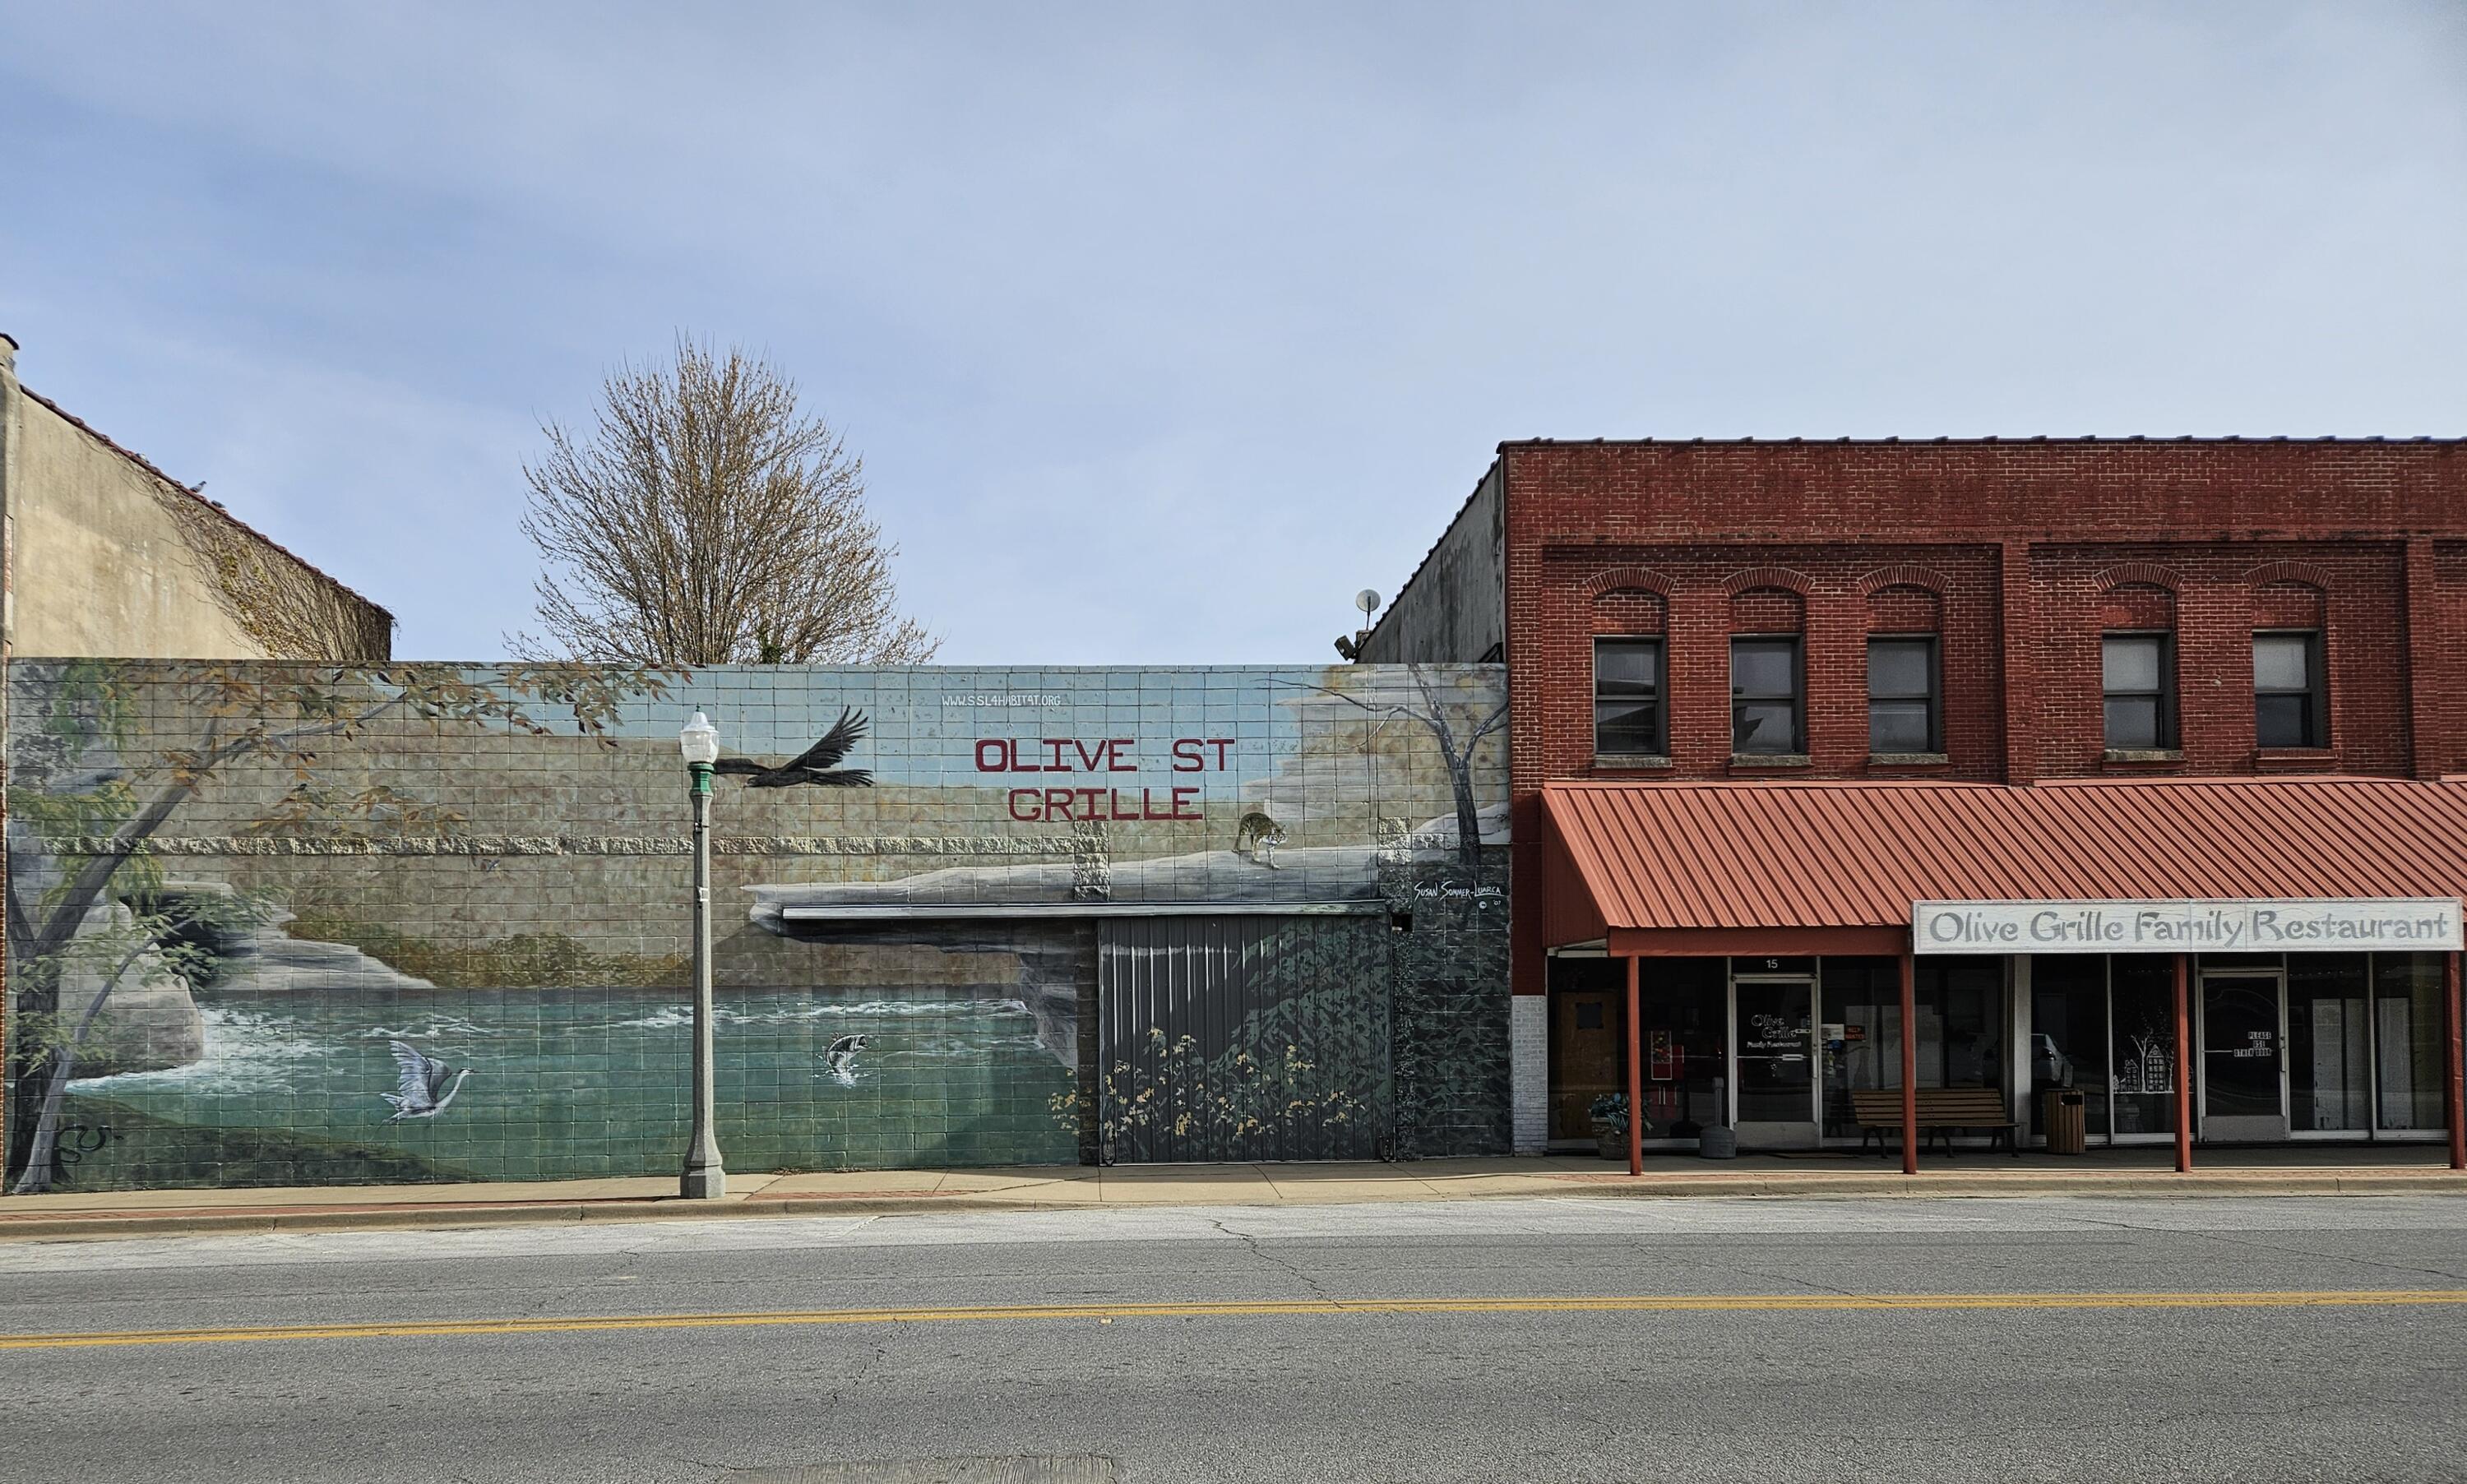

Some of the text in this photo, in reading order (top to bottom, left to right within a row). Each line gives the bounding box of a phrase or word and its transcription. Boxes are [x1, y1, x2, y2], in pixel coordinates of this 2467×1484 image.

[974, 738, 1235, 772] OLIVE ST
[1008, 788, 1203, 821] GRILLE
[1414, 881, 1438, 902] SUSAN
[1929, 910, 2448, 949] Olive Grille Family Restaurant
[1766, 959, 1778, 969] 15
[1751, 1014, 1784, 1027] Olive
[1761, 1026, 1797, 1039] Grille
[2247, 1031, 2271, 1039] PLEASE
[2253, 1040, 2265, 1048] USE
